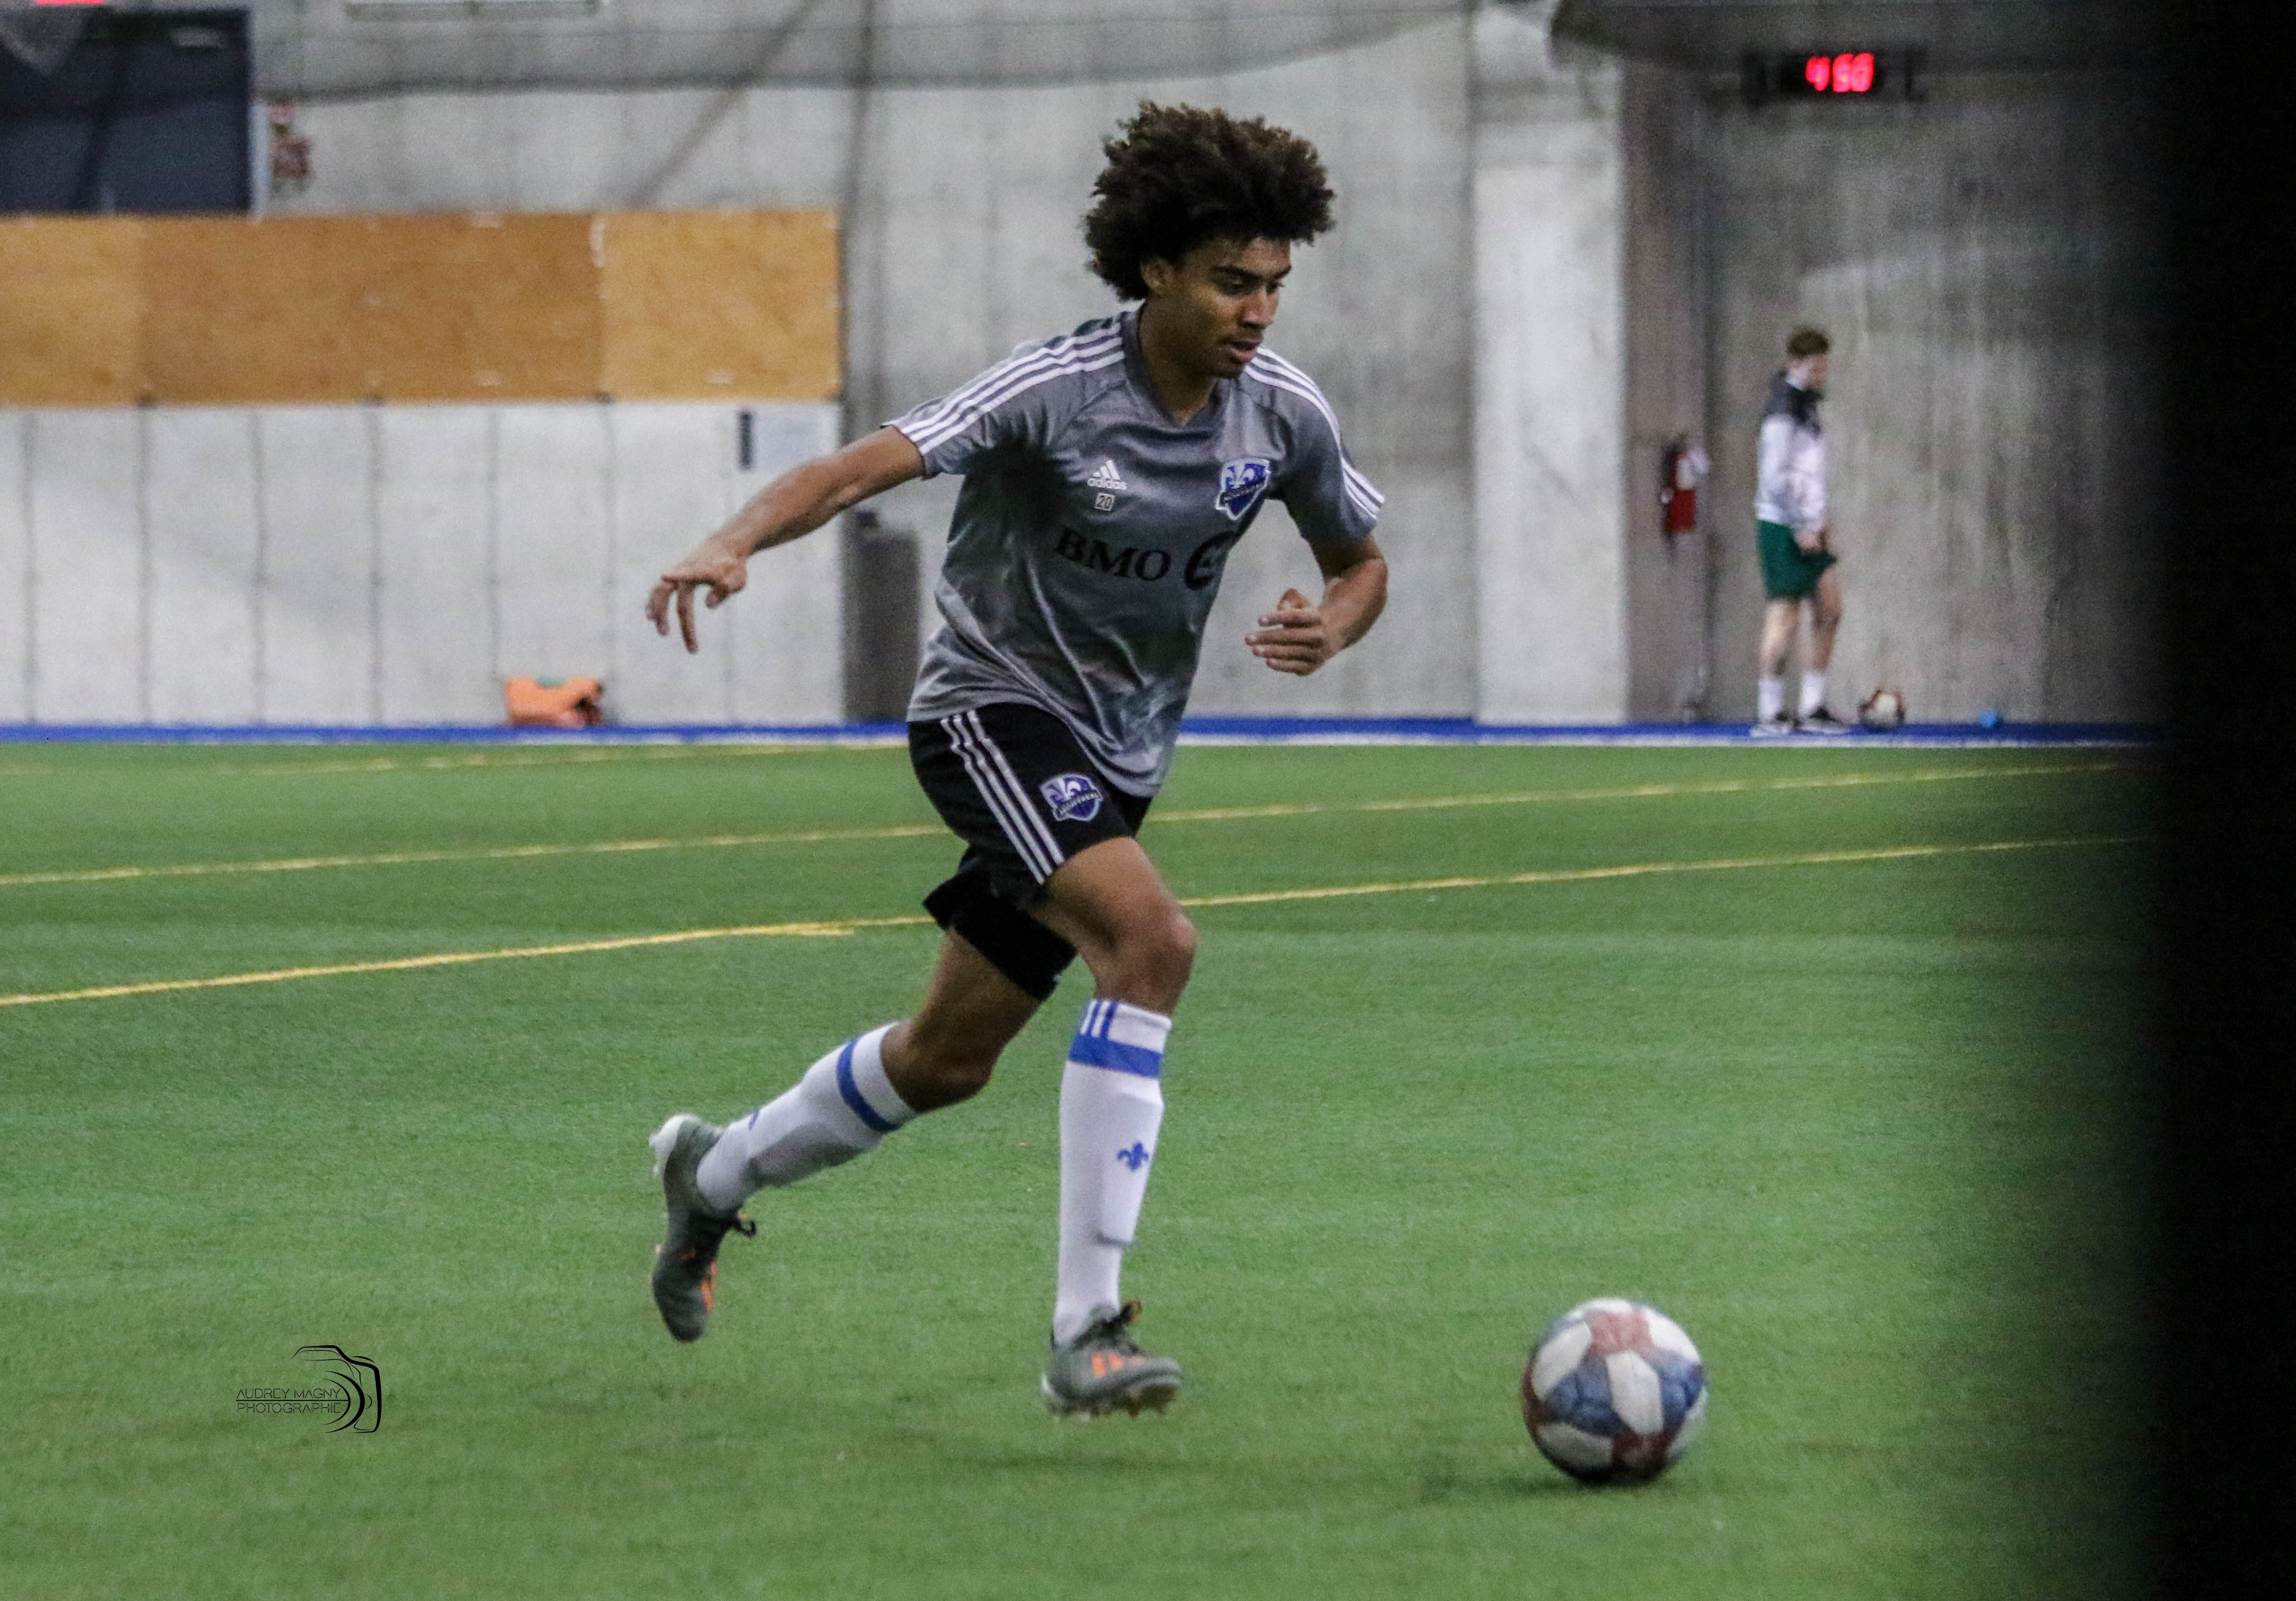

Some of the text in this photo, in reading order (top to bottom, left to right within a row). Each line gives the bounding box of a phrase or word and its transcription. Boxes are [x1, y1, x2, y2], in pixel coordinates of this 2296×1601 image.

[1087, 477, 1127, 491] adidas
[1097, 495, 1112, 509] 20
[1055, 527, 1172, 581] BMO
